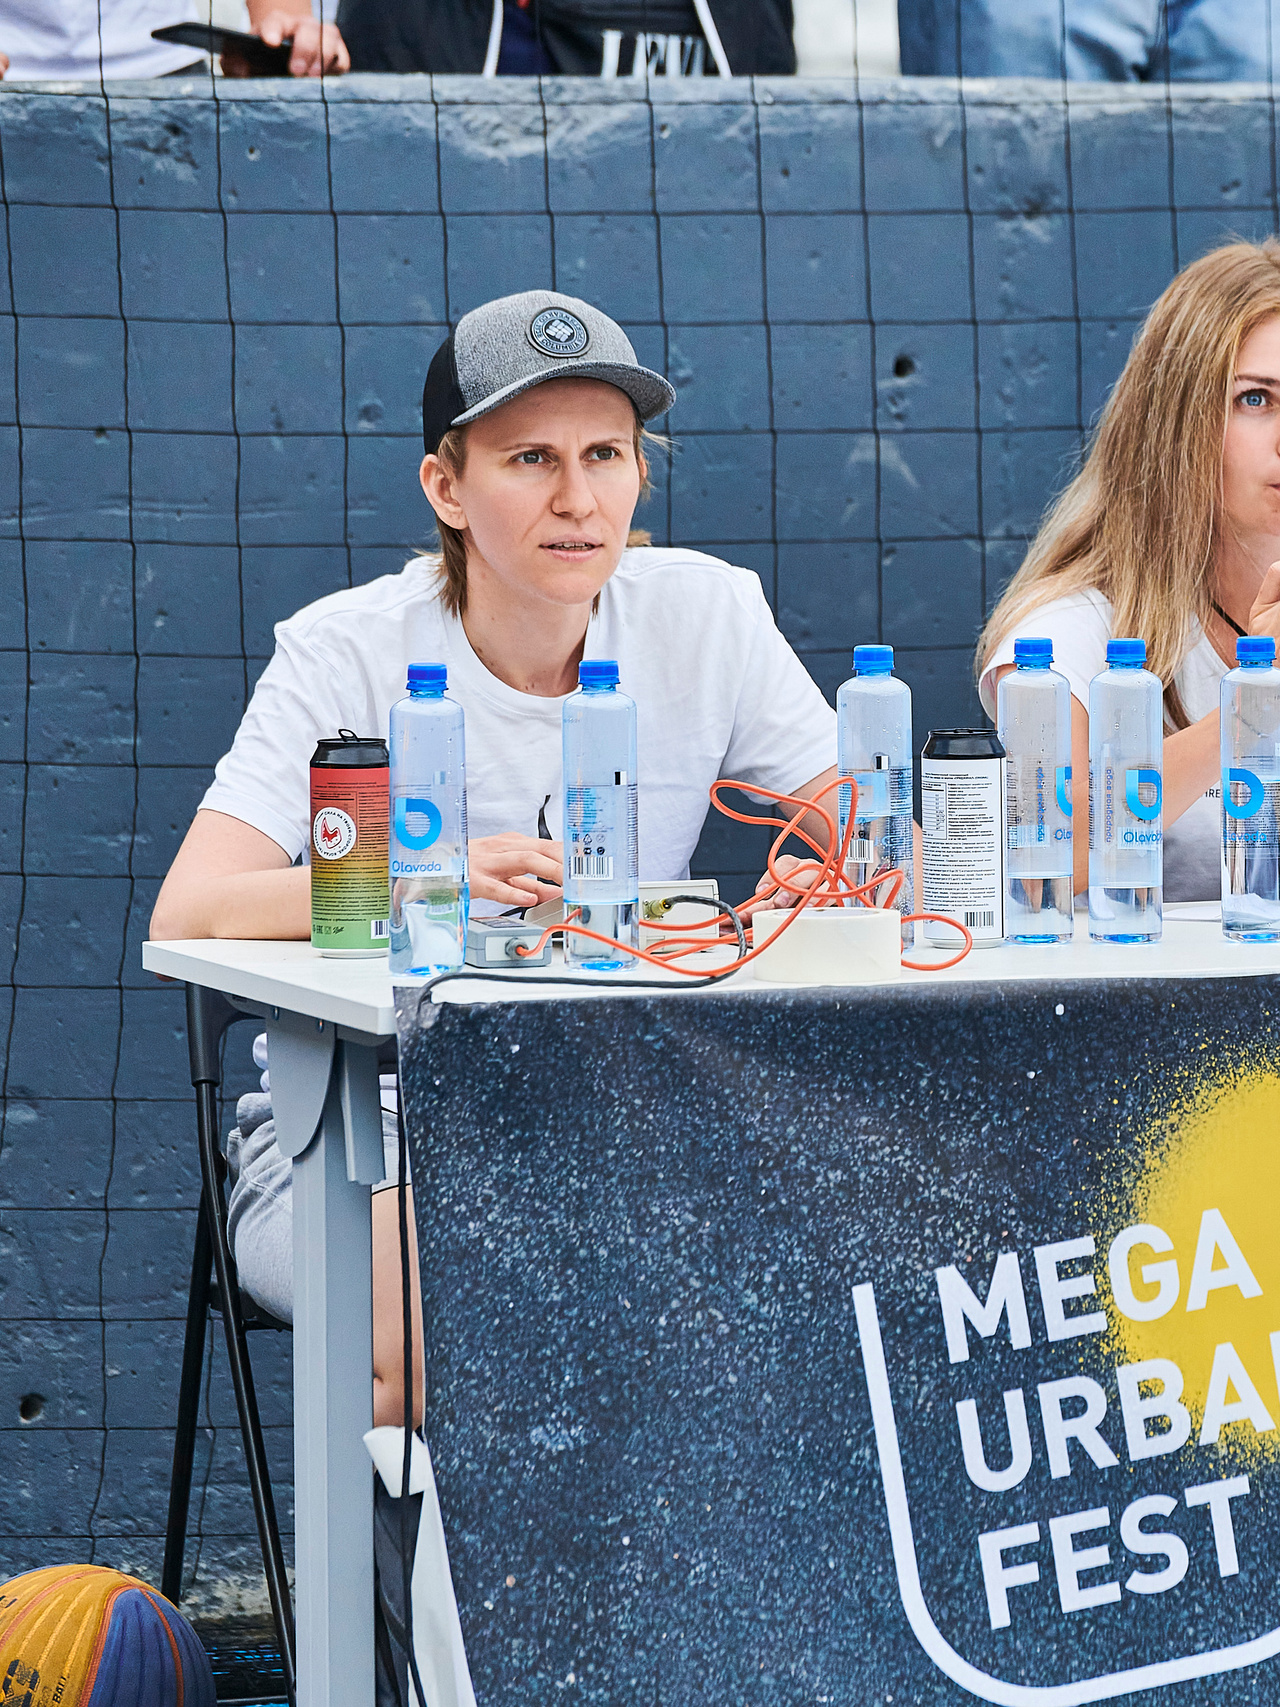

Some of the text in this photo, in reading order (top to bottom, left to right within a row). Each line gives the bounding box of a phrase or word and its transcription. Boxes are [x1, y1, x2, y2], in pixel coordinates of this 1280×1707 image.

[392, 860, 441, 873] Olavoda
[935, 1207, 1264, 1365] MEGA
[977, 1476, 1251, 1631] FEST
